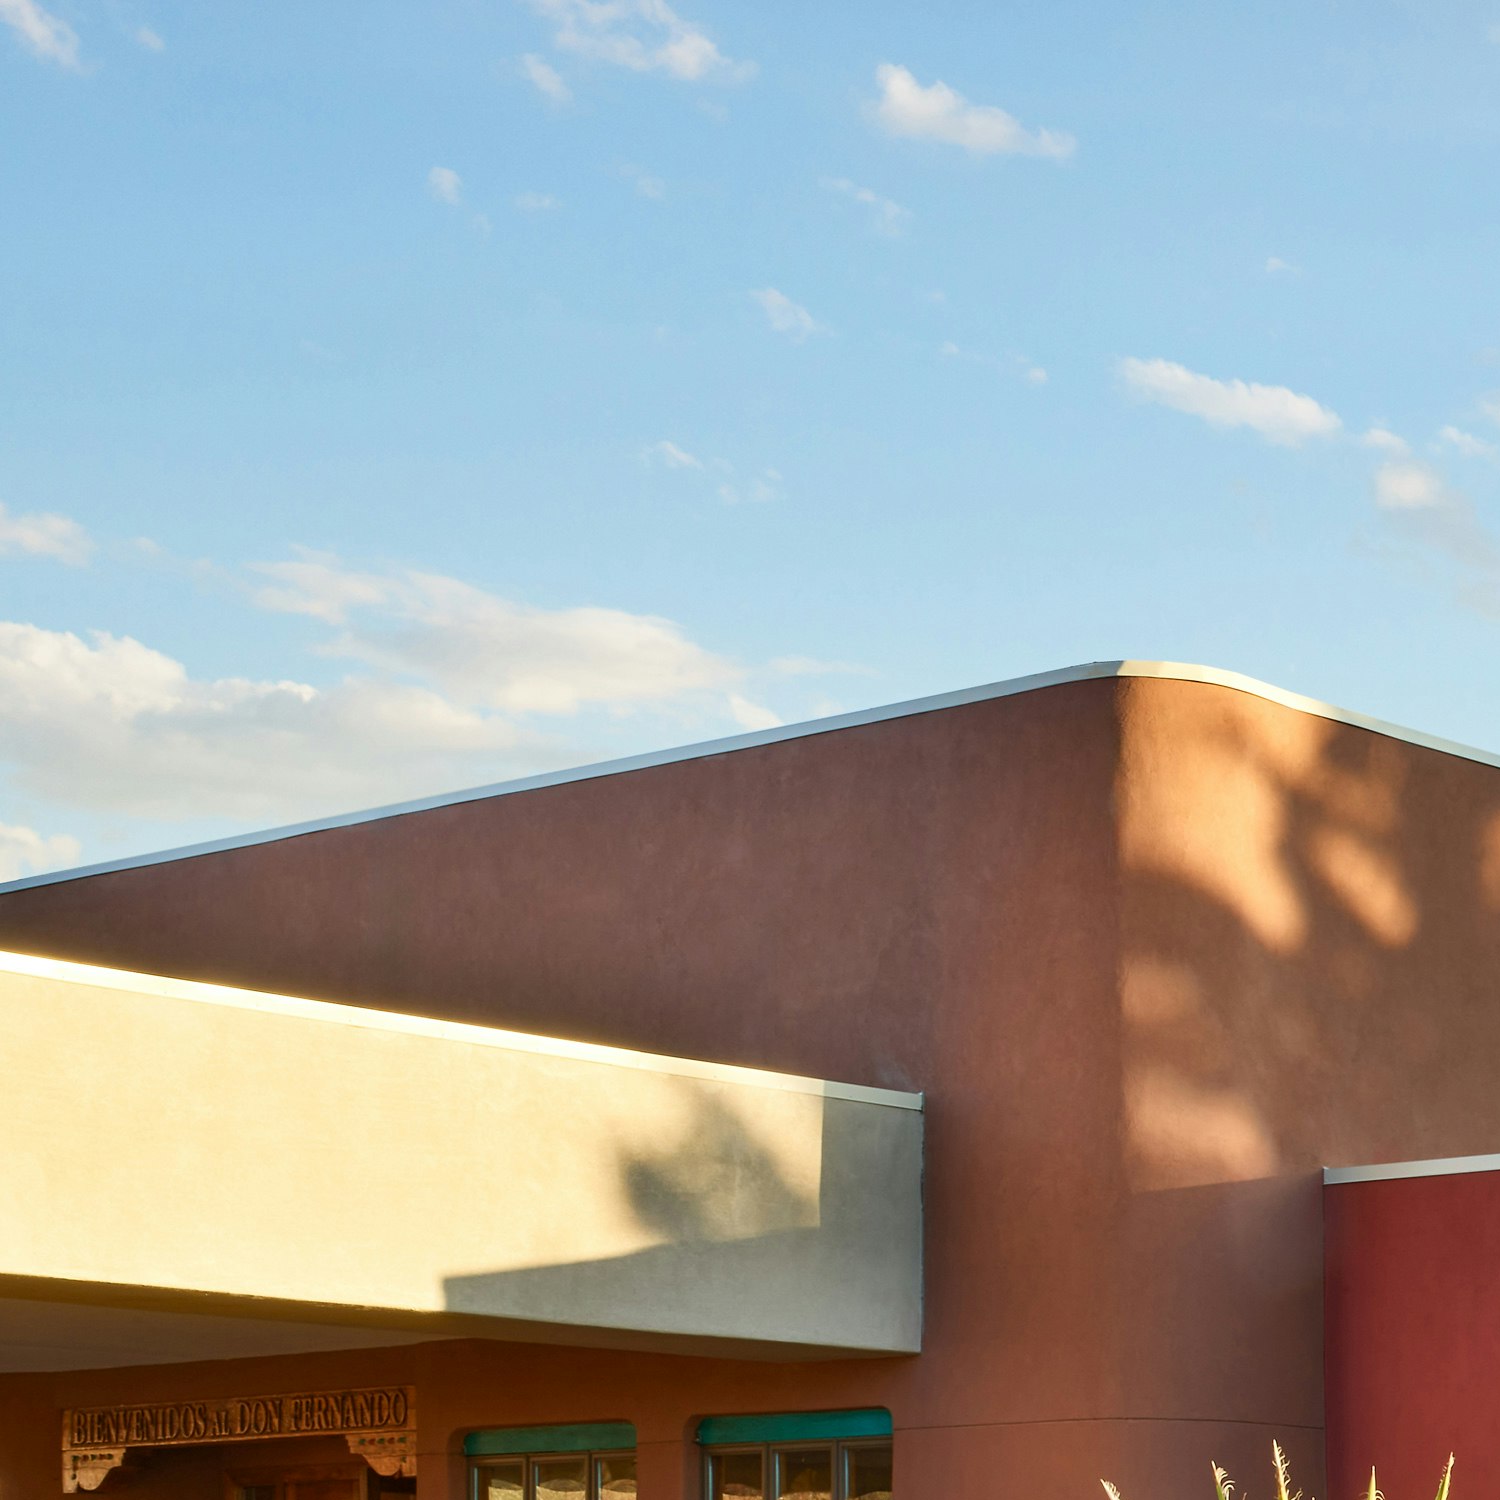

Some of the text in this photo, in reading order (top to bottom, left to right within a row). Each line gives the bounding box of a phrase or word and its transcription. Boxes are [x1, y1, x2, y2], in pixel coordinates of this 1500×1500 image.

[73, 1389, 407, 1445] BIENVENIDOS AL DON FERNANDO
